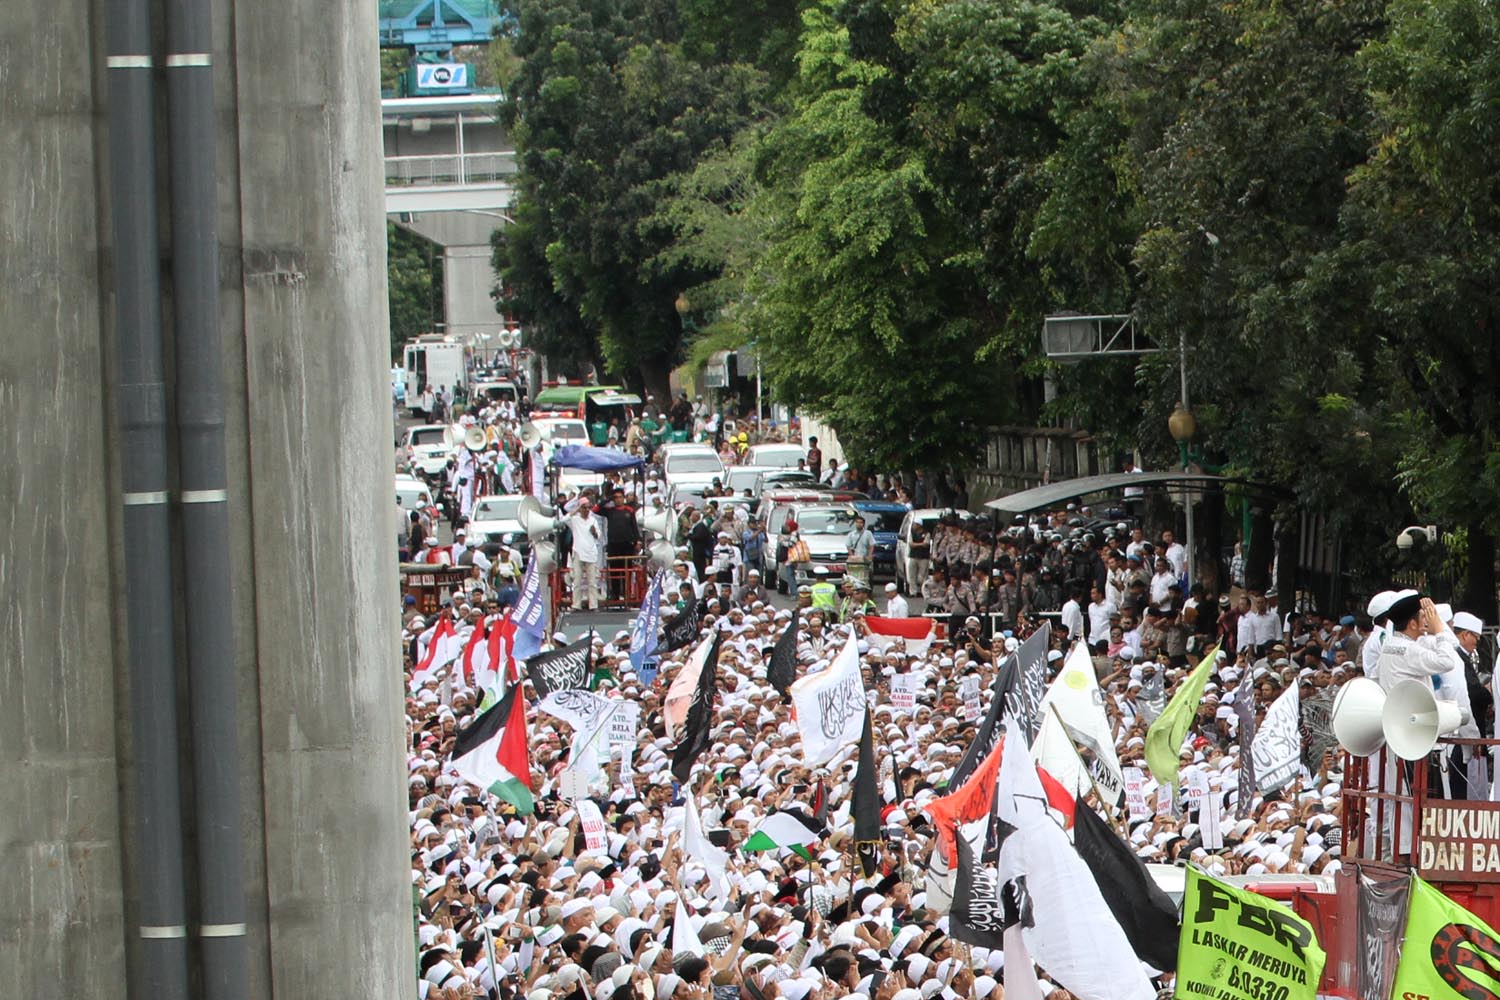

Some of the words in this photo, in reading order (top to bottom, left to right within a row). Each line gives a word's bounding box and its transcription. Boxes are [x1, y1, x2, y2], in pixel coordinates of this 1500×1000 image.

[1422, 807, 1500, 840] HUKUM
[1420, 840, 1465, 871] DAN
[1194, 878, 1312, 965] FBR
[1192, 928, 1250, 962] LASKAR
[1247, 949, 1308, 986] MERUYA
